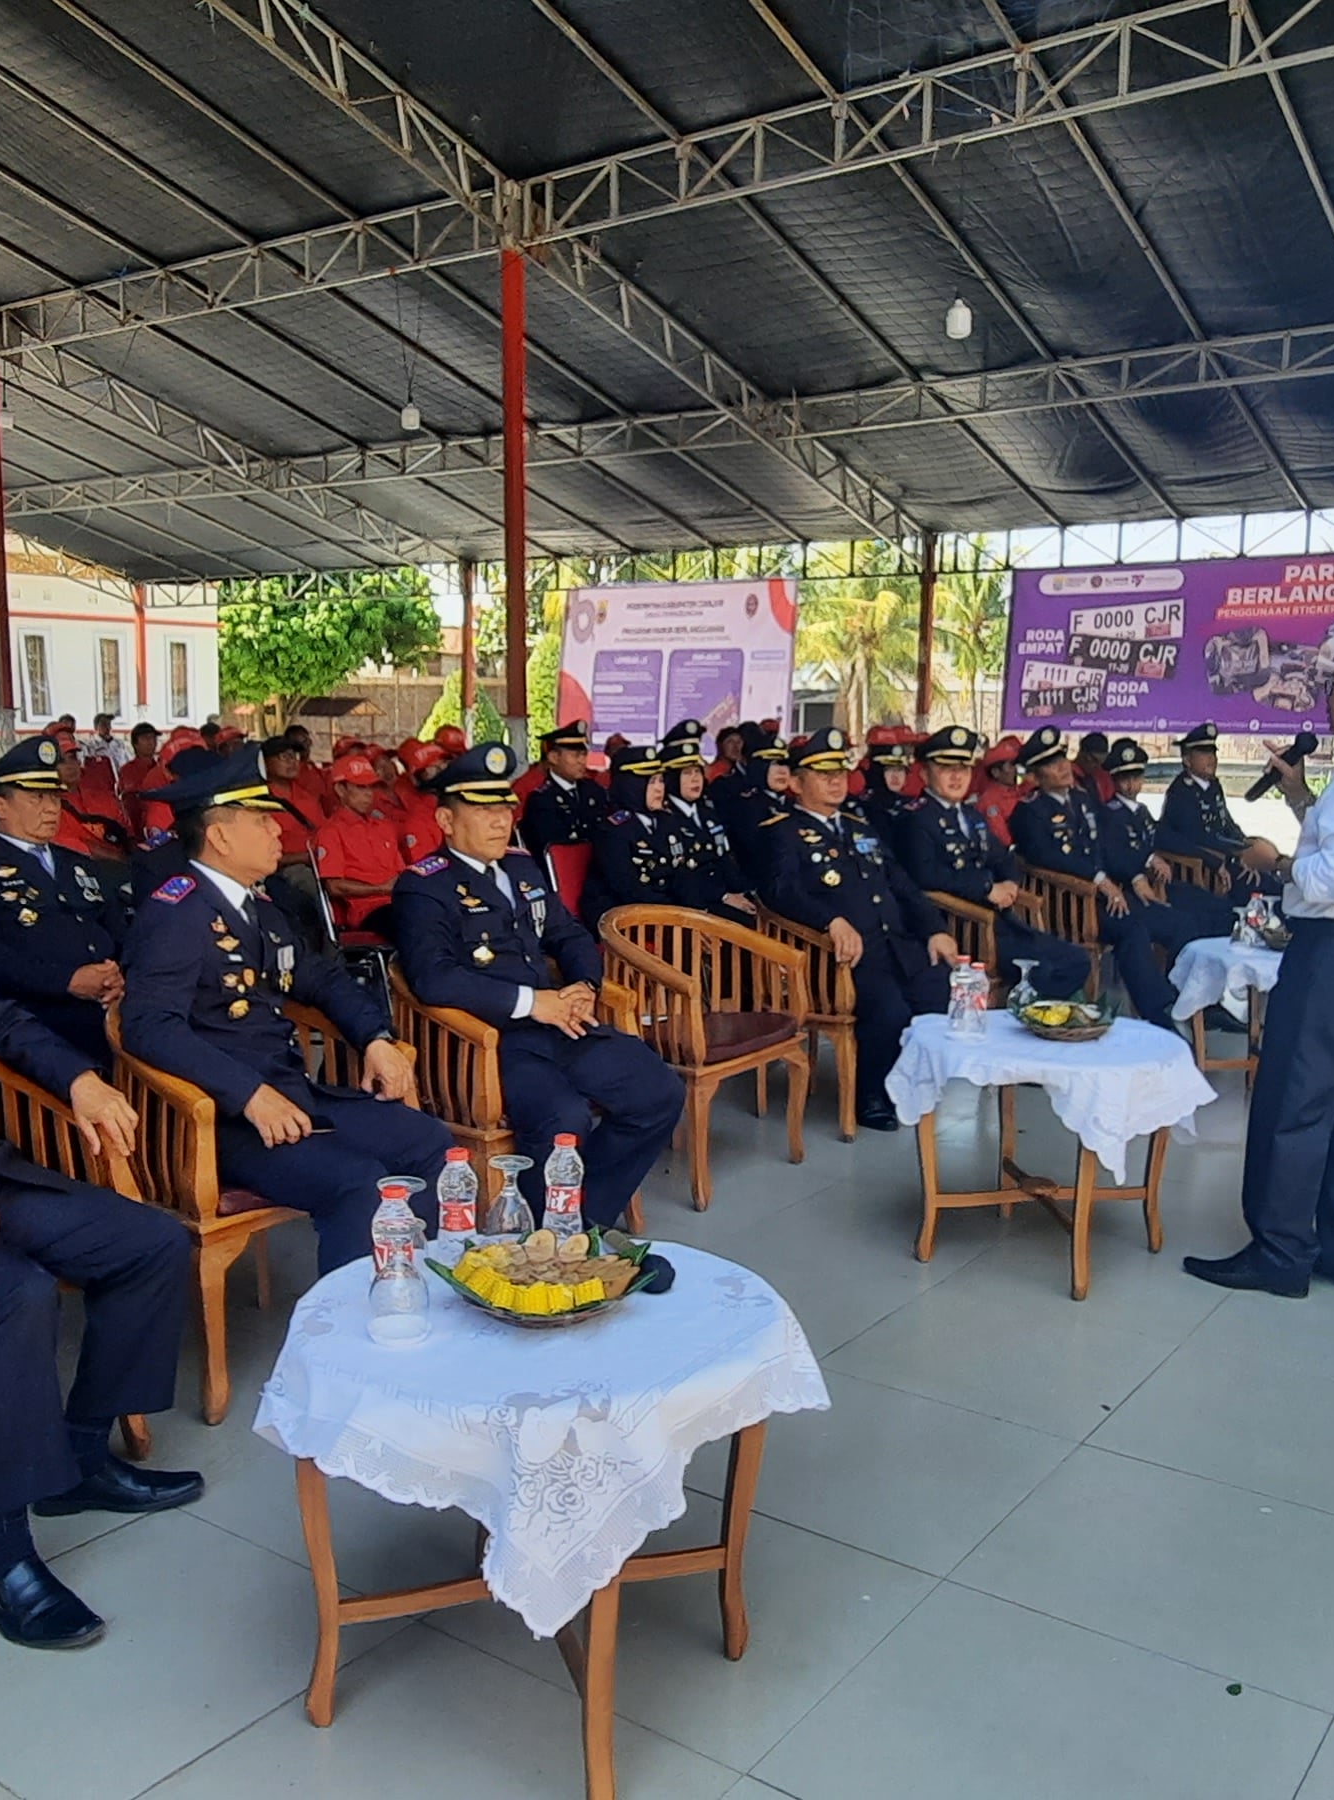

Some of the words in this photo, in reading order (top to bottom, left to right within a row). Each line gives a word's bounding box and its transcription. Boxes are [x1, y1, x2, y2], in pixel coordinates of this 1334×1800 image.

[1073, 614, 1084, 633] F
[1094, 609, 1134, 630] 0000
[1144, 604, 1182, 624] CJR
[1217, 606, 1291, 618] PENGGUNAAN
[1025, 629, 1065, 642] RODA
[1018, 642, 1065, 655] EMPAT
[1069, 636, 1083, 655] F
[1089, 638, 1131, 661] 0000
[1139, 643, 1177, 666] CJR
[1107, 681, 1149, 694] RODA
[1071, 686, 1100, 703] CJR
[1106, 694, 1138, 707] DUA
